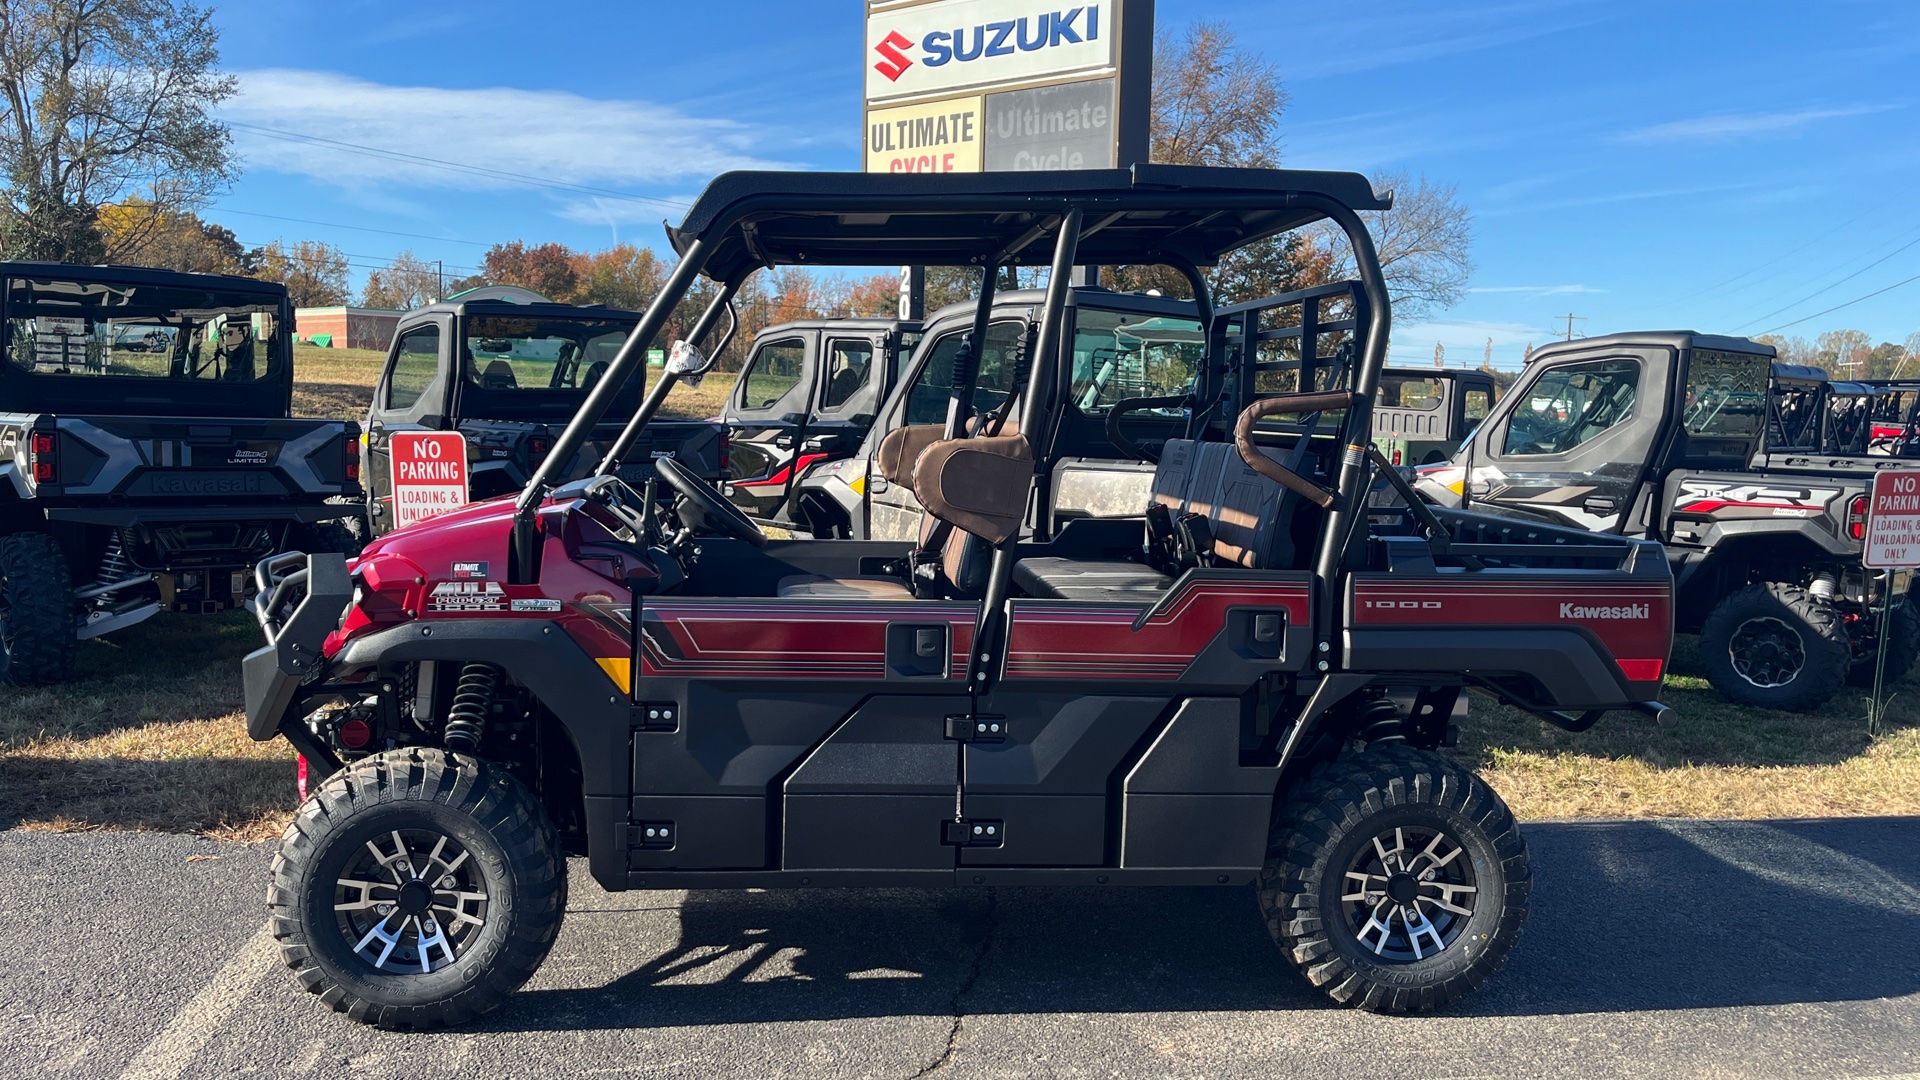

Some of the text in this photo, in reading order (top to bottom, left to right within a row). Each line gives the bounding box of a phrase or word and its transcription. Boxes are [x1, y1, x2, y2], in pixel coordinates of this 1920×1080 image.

[921, 4, 1099, 67] SUZUKI
[997, 101, 1107, 139] Ultimate
[871, 111, 974, 153] ULTIMATE
[1014, 147, 1084, 170] Cycle
[414, 441, 441, 458] NO
[400, 462, 459, 479] PARKING
[152, 475, 266, 493] Kawasaki
[1893, 477, 1916, 493] NO
[402, 491, 459, 504] LOADING &
[1878, 496, 1920, 511] PARKIN
[1876, 519, 1912, 531] LOADING
[1884, 548, 1907, 559] ONLY
[429, 582, 507, 597] MULE
[1365, 601, 1442, 609] 1000
[1560, 602, 1649, 619] Kawasaki
